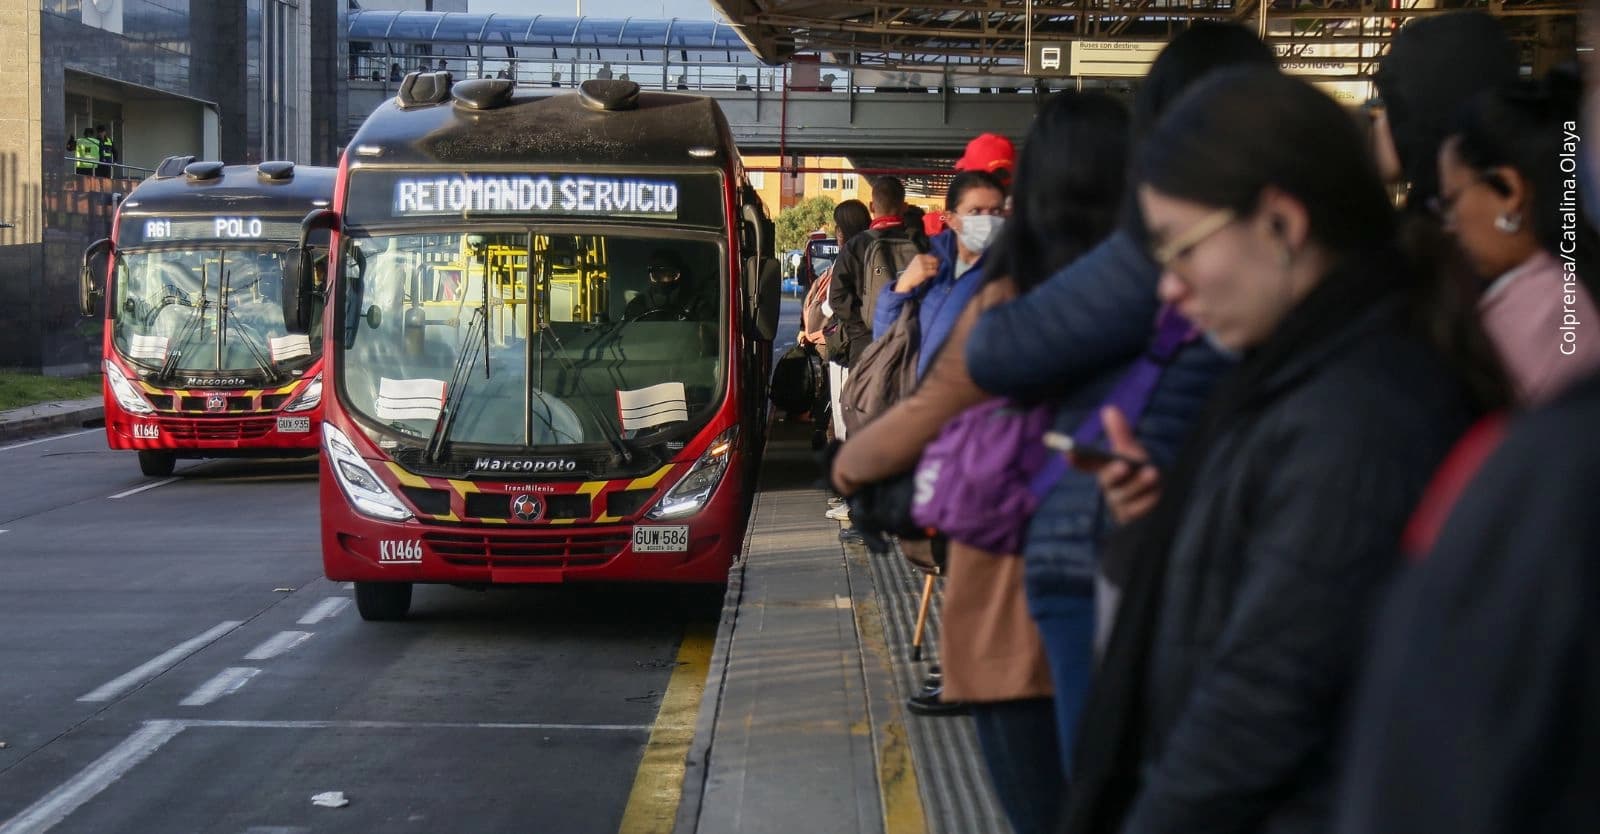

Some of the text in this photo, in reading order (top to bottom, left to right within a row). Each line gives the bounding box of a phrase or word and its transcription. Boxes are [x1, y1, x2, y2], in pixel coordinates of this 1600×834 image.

[395, 178, 678, 213] RETOMANDO SERVICIO
[215, 218, 262, 238] POLO
[187, 377, 246, 386] Marcopolo
[133, 423, 160, 437] K1646
[294, 418, 309, 429] 935
[474, 458, 577, 473] Marcopolo
[504, 484, 555, 492] TransMilenio
[635, 530, 687, 545] GUW 586
[379, 539, 423, 561] K1466
